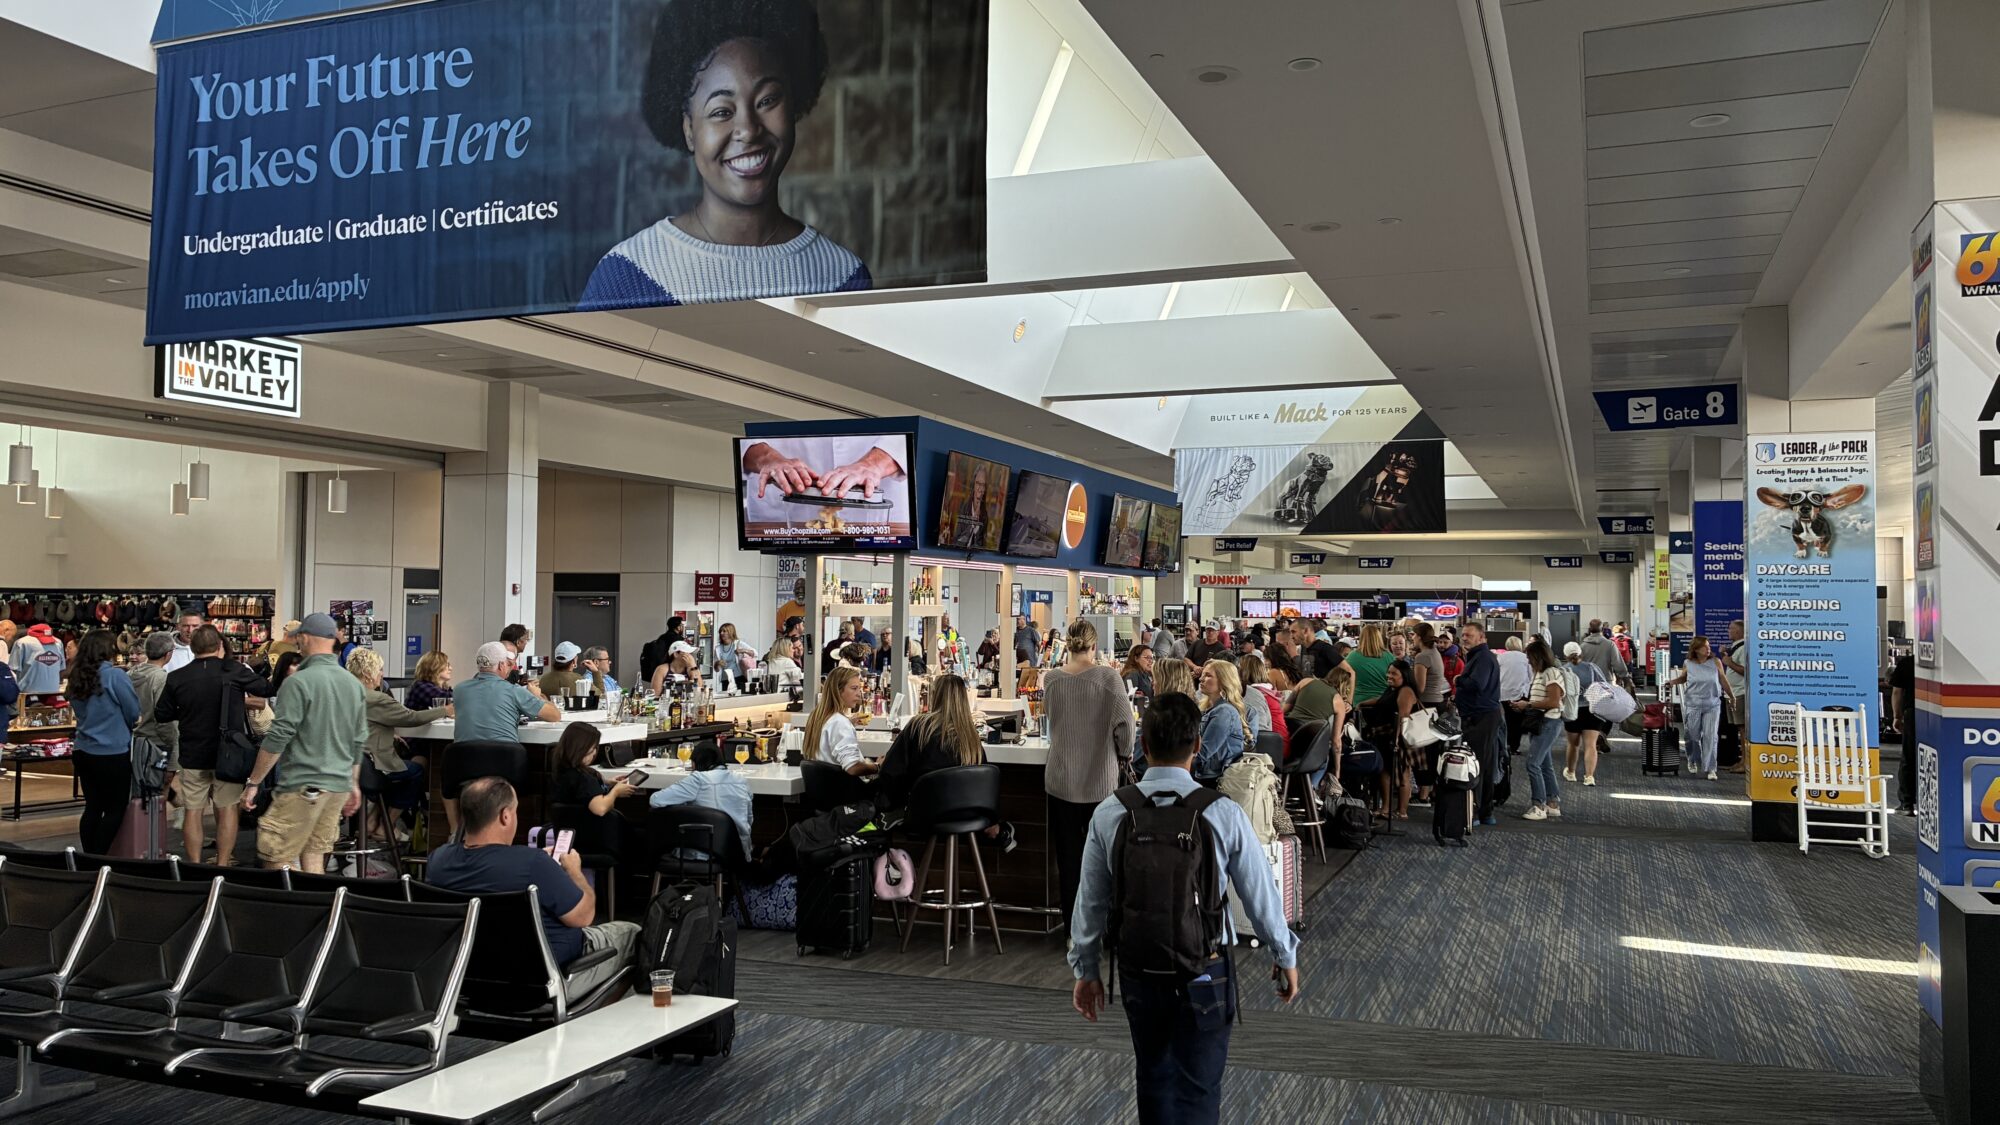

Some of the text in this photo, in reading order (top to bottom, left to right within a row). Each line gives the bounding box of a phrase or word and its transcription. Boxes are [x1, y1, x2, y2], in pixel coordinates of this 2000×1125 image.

[190, 47, 474, 123] Your Future
[188, 114, 532, 196] Takes Off Here
[183, 200, 558, 256] Undergraduate Graduate Certificates
[184, 272, 370, 310] moravian.edu/apply
[1964, 284, 2000, 295] WFM
[178, 340, 291, 376] MARKET
[178, 360, 194, 377] IN
[178, 376, 194, 386] THE
[199, 366, 289, 400] VALLEY
[1664, 391, 1724, 421] Gate 8
[1210, 414, 1236, 422] BUILT
[1274, 402, 1328, 424] Mack
[1374, 406, 1407, 414] YEARS
[1782, 440, 1868, 455] LEADER of the PACK
[764, 526, 890, 536] www.BuyChopzilla.com 1-800-980-1031
[1646, 519, 1654, 531] 9
[1704, 562, 1724, 570] not
[1756, 564, 1831, 575] DAYCARE
[699, 576, 713, 585] AED
[1200, 575, 1250, 585] DUNKIN'
[1757, 599, 1840, 610] BOARDING
[1758, 629, 1846, 641] GROOMING
[1758, 660, 1835, 672] TRAINING
